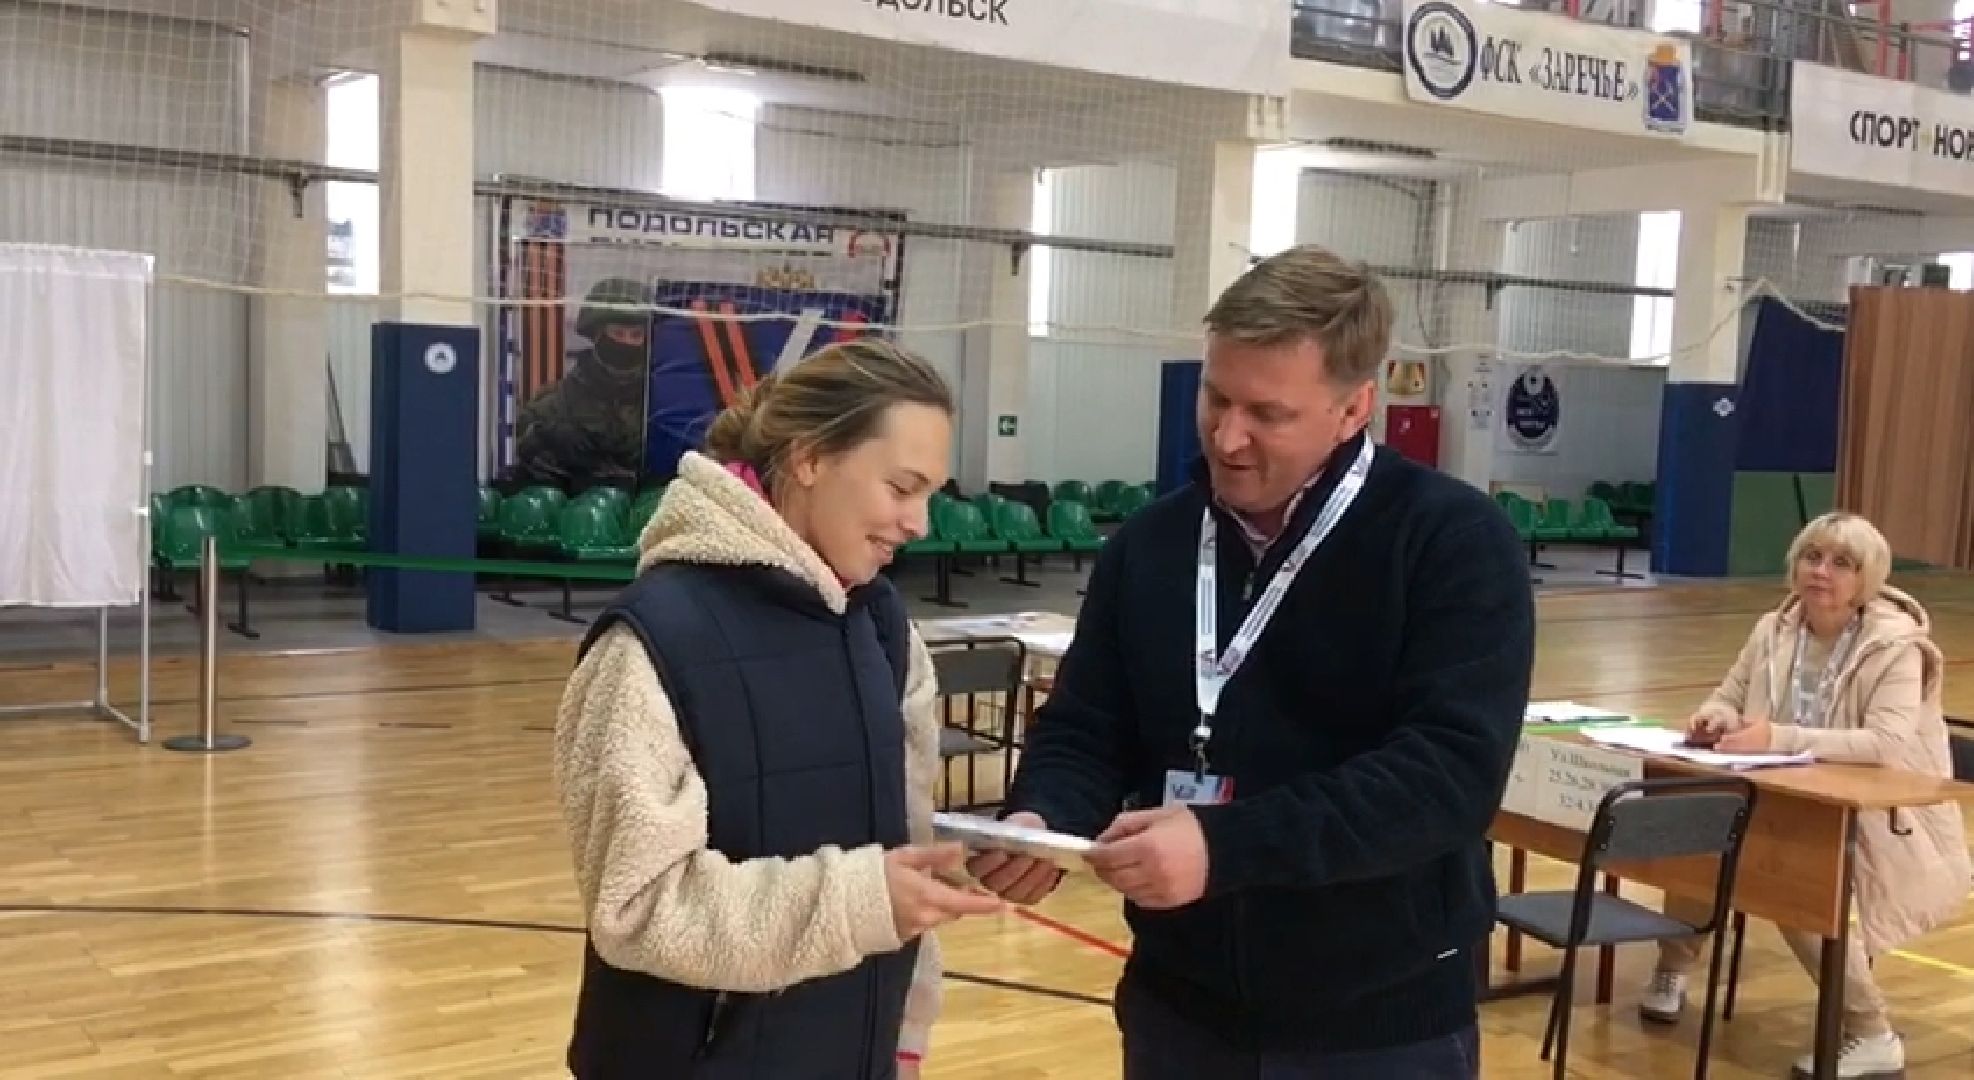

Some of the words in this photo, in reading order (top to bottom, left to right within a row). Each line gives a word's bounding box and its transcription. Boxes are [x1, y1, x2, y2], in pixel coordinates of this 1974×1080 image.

[1480, 35, 1523, 84] ФСК
[1850, 109, 1921, 152] СПОРТ
[588, 207, 834, 245] ПОДОЛЬСКАЯ
